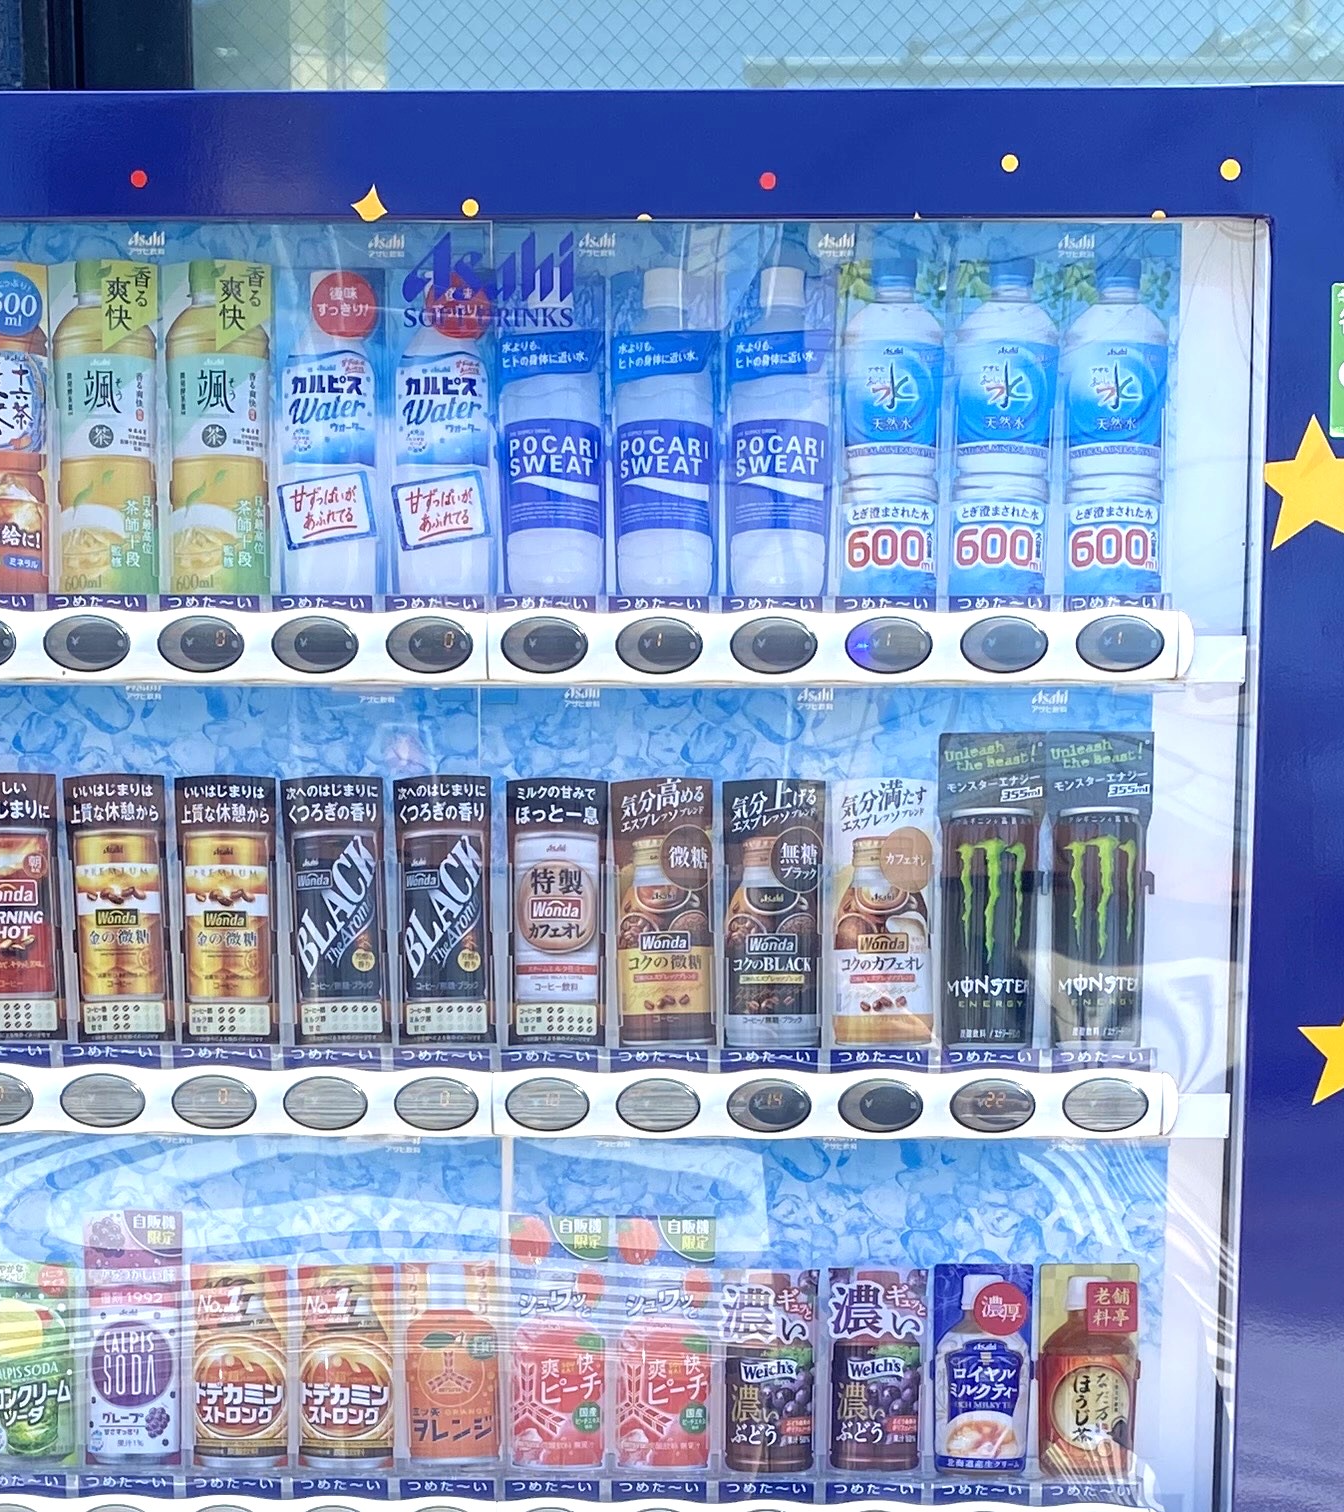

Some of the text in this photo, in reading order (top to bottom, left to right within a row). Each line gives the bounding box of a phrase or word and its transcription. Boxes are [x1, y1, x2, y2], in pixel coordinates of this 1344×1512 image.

[401, 231, 574, 303] Asahi
[126, 267, 151, 307] 香る
[106, 276, 132, 331] 爽快
[291, 375, 363, 395] カルピス
[406, 377, 477, 396] カルピス
[289, 396, 366, 425] Water
[403, 397, 482, 426] Water
[873, 416, 913, 431] 天然水
[985, 416, 1025, 430] 天然水
[509, 435, 599, 459] POCARI
[620, 435, 709, 459] POCARI
[736, 435, 825, 459] POCARI
[509, 454, 594, 478] SWEAT
[620, 454, 703, 478] SWEAT
[736, 454, 819, 478] SWEAT
[852, 507, 930, 522] とぎ澄まされた水
[961, 506, 1040, 520] とぎ澄まされた水
[847, 528, 925, 568] 600
[65, 574, 102, 592] 600ml
[944, 740, 1005, 762] Unleash
[1050, 739, 1113, 760] Unleash
[956, 758, 983, 771] the
[73, 784, 153, 798] いいはじまりは
[947, 774, 1041, 793] モンスターエナジー
[1054, 771, 1149, 791] モンスターエナジー
[183, 785, 263, 799] いいはじまりは
[286, 783, 378, 800] 次へのはじまりに
[398, 783, 486, 800] 次へのはじまりに
[516, 785, 596, 800] ミルクの甘みで
[620, 778, 705, 821] 気分高める
[731, 780, 817, 822] 気分上げる
[840, 778, 927, 821] 気分満たす
[1001, 787, 1042, 801] 355ml
[71, 802, 159, 824] 上質な休憩から
[181, 803, 269, 825] 上質な休憩から
[288, 802, 376, 824] くつろぎの香り
[400, 802, 484, 824] くつろぎの香り
[515, 804, 599, 825] ほっと一息
[668, 846, 708, 869] 微糖
[780, 842, 818, 866] 無糖
[85, 867, 149, 876] PREMIUM
[195, 868, 259, 877] PREMIUM
[530, 868, 583, 895] 特製
[780, 866, 818, 880] ブラック
[297, 835, 376, 979] BLACK
[405, 835, 482, 979] BLACK
[528, 924, 586, 939] カフェオレ
[629, 955, 702, 971] コクの微糖
[733, 956, 812, 972] コクのBLACK
[841, 956, 925, 971] コクのカフェオレ
[958, 1000, 1025, 1008] ENERGY
[133, 1215, 176, 1231] 自販機
[559, 1219, 602, 1234] 自販機
[147, 1231, 176, 1245] 限定
[573, 1235, 602, 1249] 限定
[1093, 1287, 1131, 1306] 老舗
[981, 1295, 1022, 1323] 濃厚
[1092, 1309, 1130, 1327] 料亭
[103, 1331, 155, 1353] CALPIS
[24, 1361, 59, 1377] SODA
[103, 1354, 157, 1396] SODA
[742, 1360, 795, 1379] Welch's
[849, 1360, 902, 1378] Welch's
[953, 1367, 1017, 1382] ロイヤル
[541, 1373, 602, 1405] ピーチ
[648, 1373, 709, 1405] ピーチ
[949, 1382, 1018, 1401] ミルクティー
[4, 1404, 45, 1427] ソーダ
[102, 1412, 145, 1424] グレープ
[202, 1406, 272, 1425] ストロング
[309, 1406, 379, 1425] ストロング
[1071, 1375, 1093, 1442] ほうじ茶
[730, 1423, 778, 1445] ぶどう
[835, 1421, 884, 1444] ぶどう
